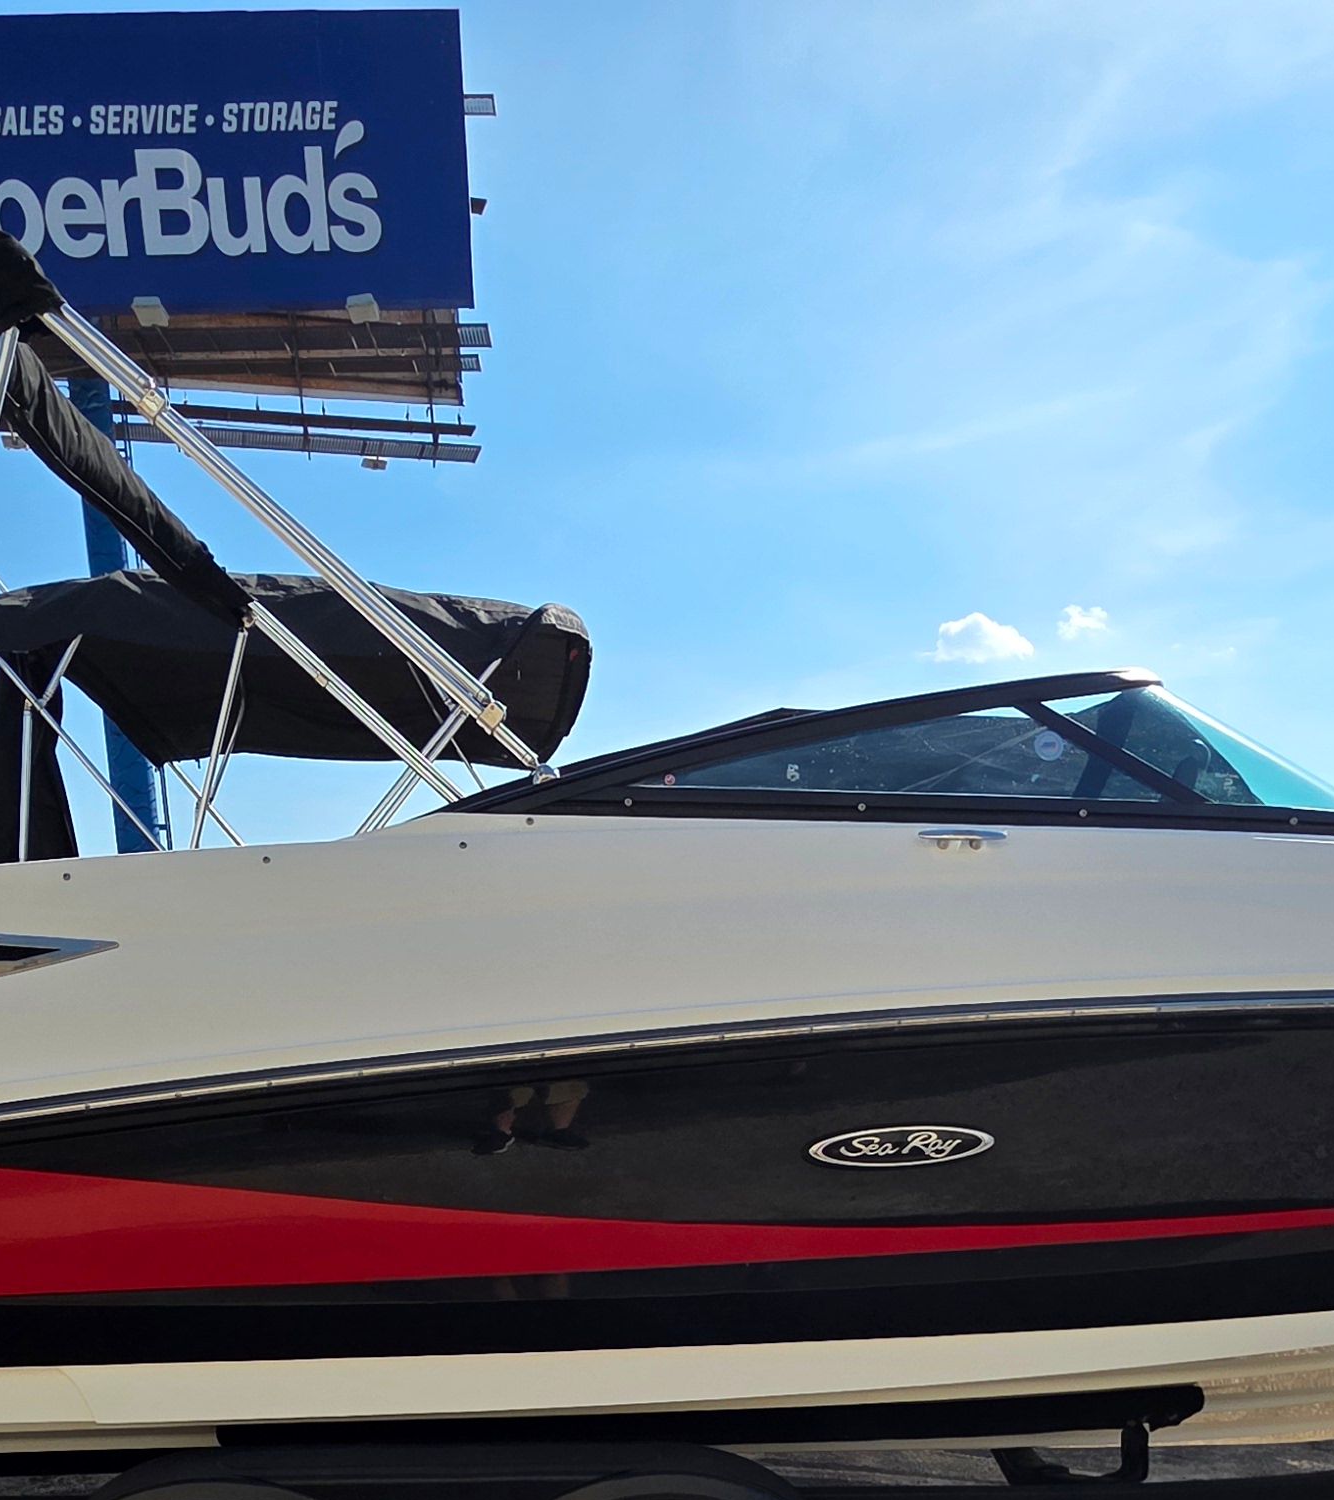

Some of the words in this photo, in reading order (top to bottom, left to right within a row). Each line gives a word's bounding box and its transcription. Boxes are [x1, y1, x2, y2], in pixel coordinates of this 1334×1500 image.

[89, 103, 198, 135] SERVICE
[222, 100, 338, 133] STORAGE
[839, 1136, 898, 1157] Sea
[901, 1131, 962, 1158] Ray
